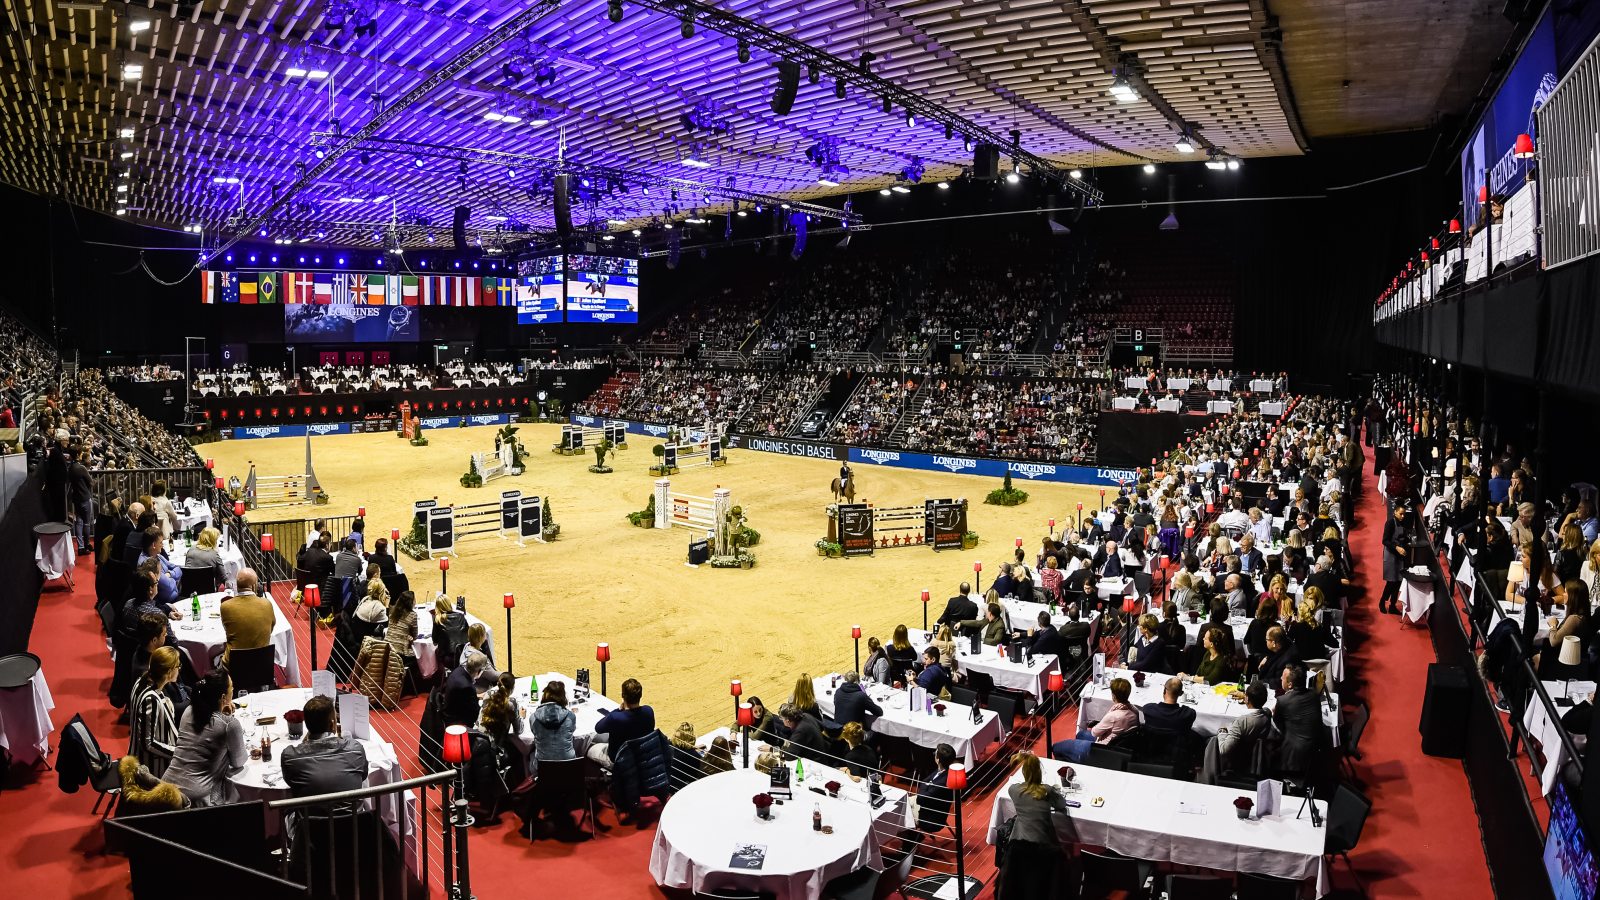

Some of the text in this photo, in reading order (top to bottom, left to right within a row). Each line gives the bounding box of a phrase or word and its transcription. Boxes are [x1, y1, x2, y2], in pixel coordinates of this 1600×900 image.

[1490, 142, 1518, 196] NGINES
[328, 307, 380, 317] LONGINES
[699, 332, 704, 341] E
[809, 331, 816, 341] D
[954, 331, 961, 340] C
[1135, 330, 1143, 341] B
[224, 350, 231, 359] G
[464, 347, 470, 355] F
[420, 418, 449, 426] LONGINES
[471, 415, 499, 423] LONGINES
[575, 416, 594, 424] LONGINES
[246, 427, 280, 435] LONGINES
[306, 424, 339, 432] LONGINES
[644, 424, 667, 433] LONGINES
[748, 438, 790, 455] LONGINES
[791, 443, 805, 456] CSI
[807, 445, 837, 460] BASEL
[861, 449, 900, 461] LONGINES
[933, 455, 976, 468] LONGINES
[1008, 462, 1056, 474] LONGINES
